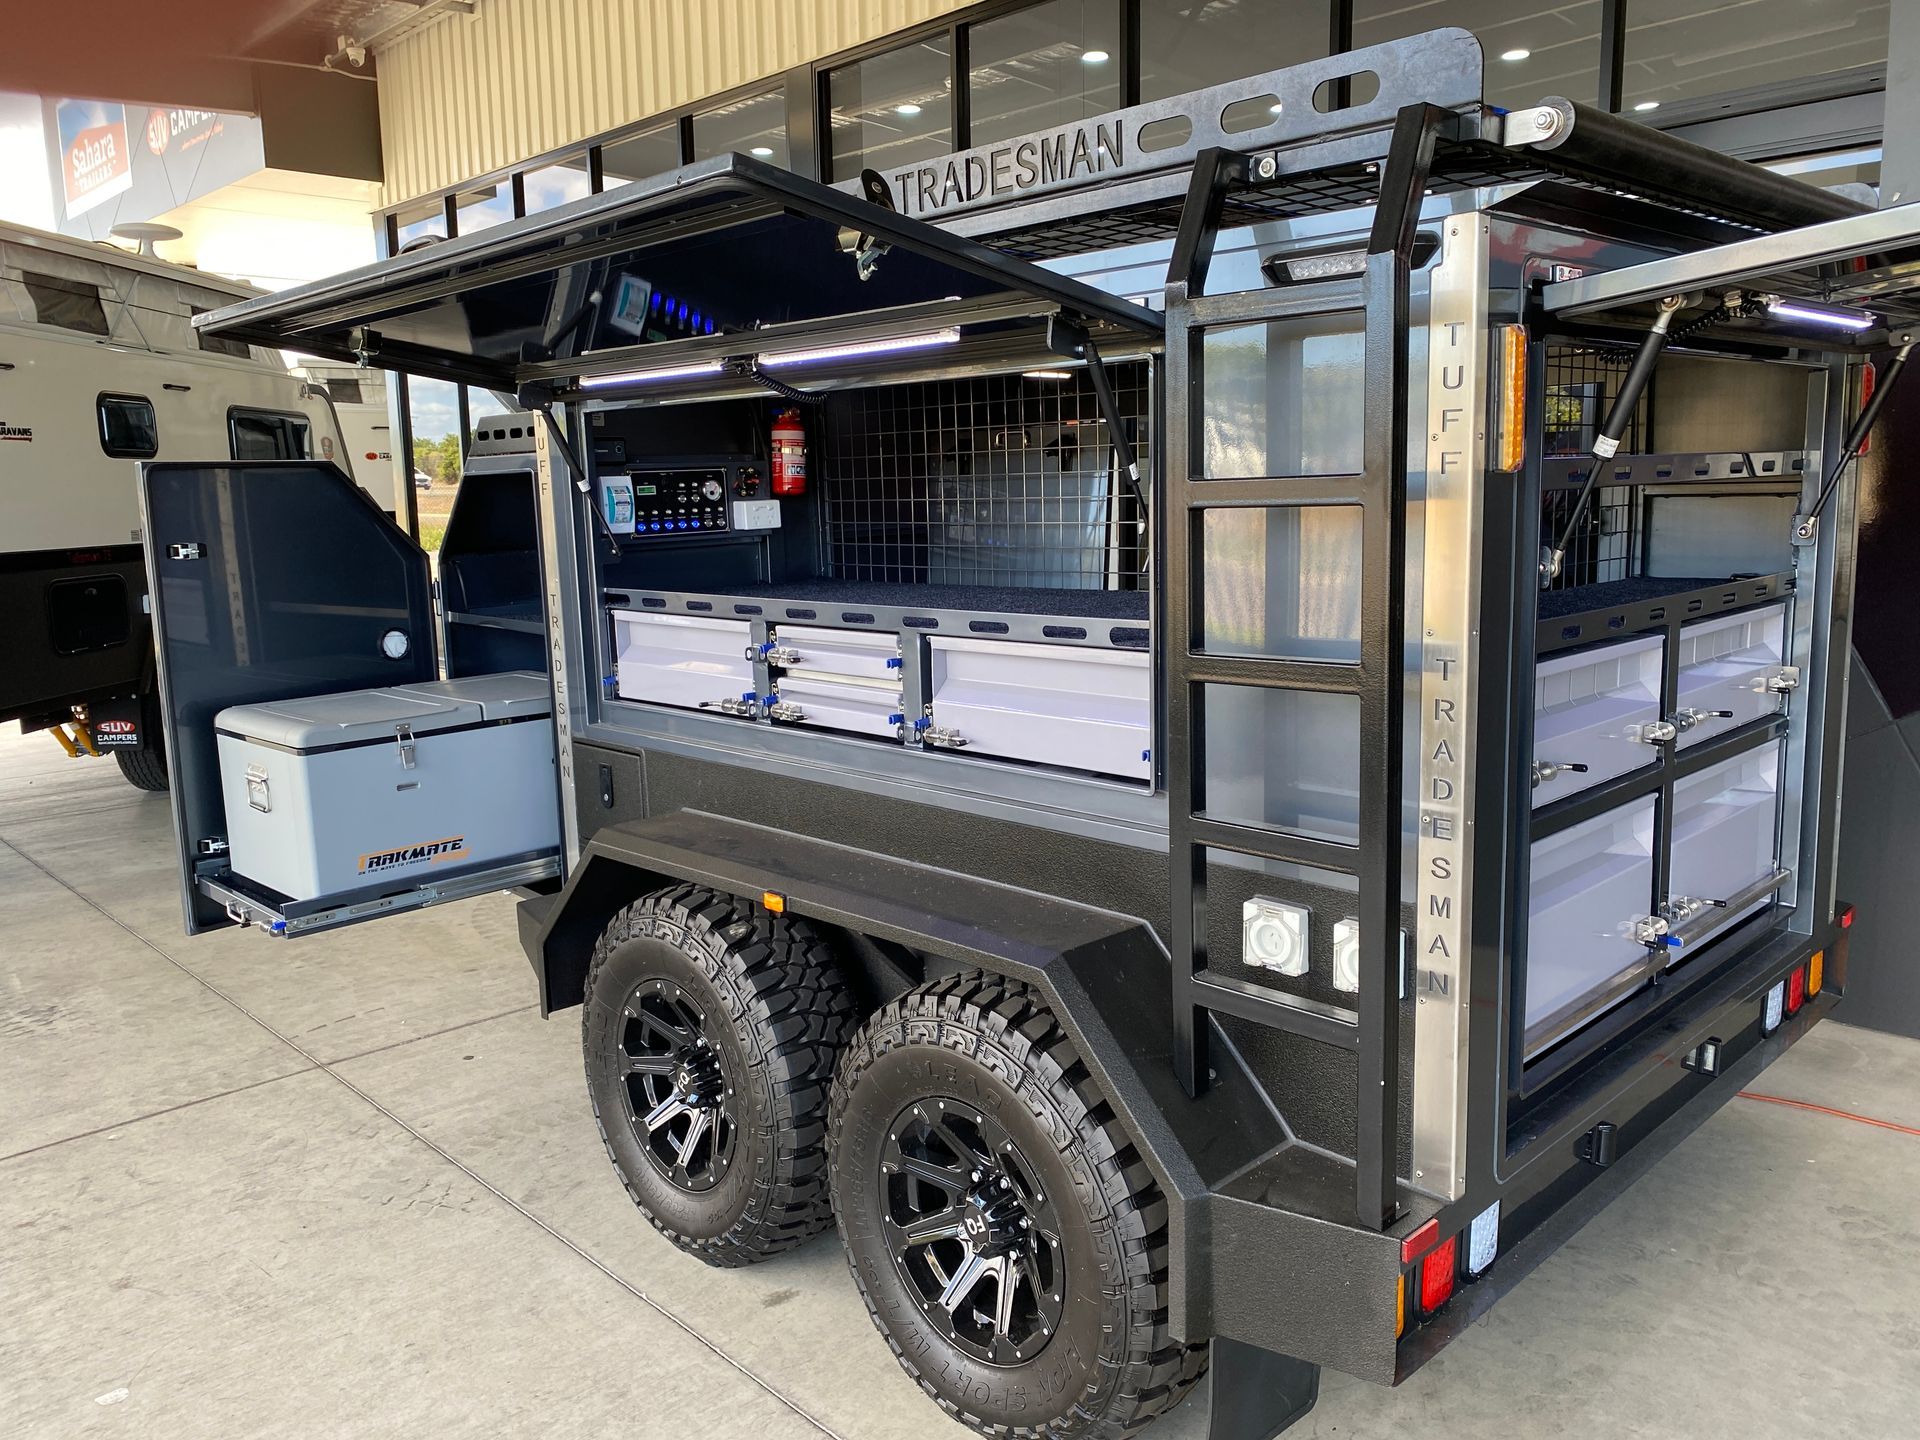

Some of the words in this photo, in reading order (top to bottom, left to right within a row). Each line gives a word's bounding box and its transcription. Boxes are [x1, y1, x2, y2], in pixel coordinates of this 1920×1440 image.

[72, 133, 115, 179] Sahara
[149, 114, 168, 151] SUV
[895, 119, 1123, 215] TRADESMAN
[1440, 321, 1465, 475] TUFF
[536, 414, 548, 495] TUFF
[550, 594, 571, 778] TRADESMAN
[101, 722, 131, 732] SUV
[1428, 658, 1456, 996] TRADESMAN
[964, 1214, 986, 1235] FQ
